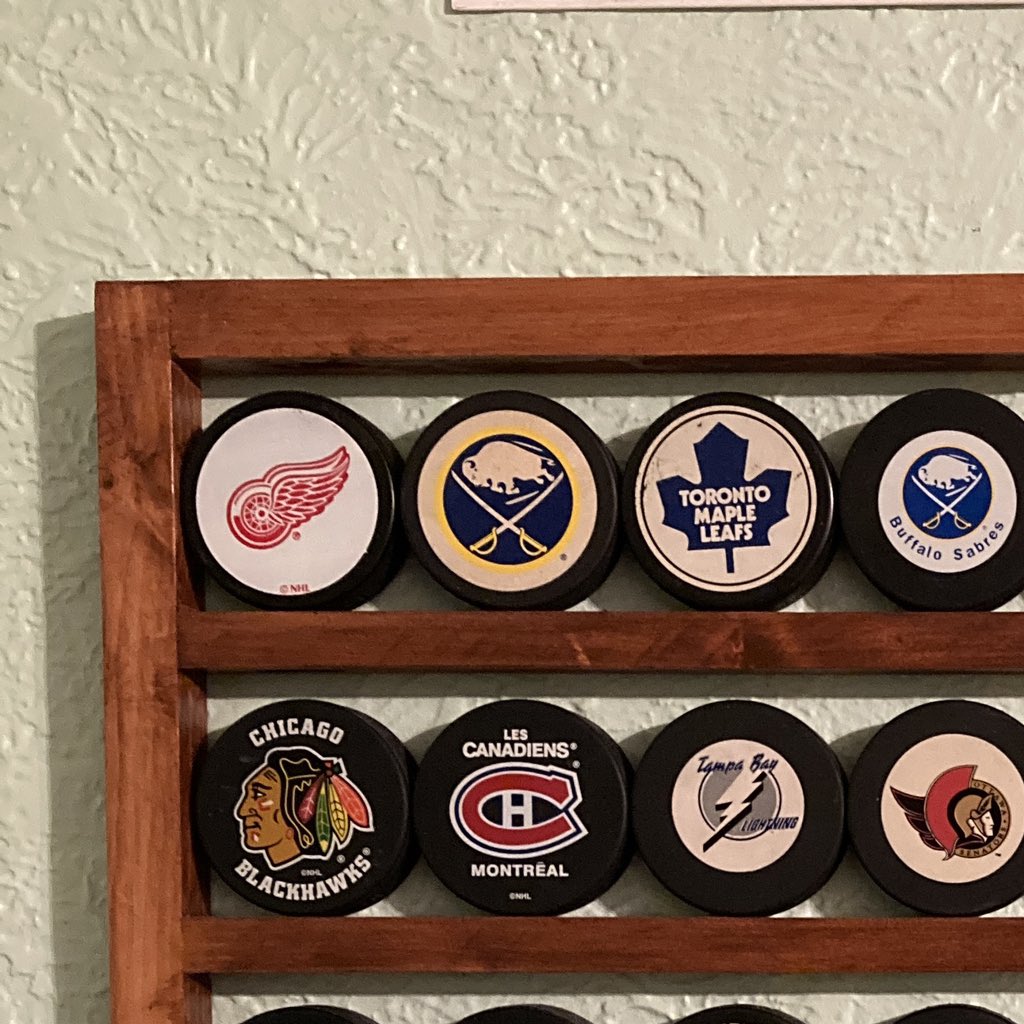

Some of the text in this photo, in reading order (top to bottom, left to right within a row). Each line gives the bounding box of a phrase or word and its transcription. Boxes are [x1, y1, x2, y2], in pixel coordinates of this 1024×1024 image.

[679, 486, 771, 507] TORONTO
[694, 505, 757, 525] MAPLE
[700, 524, 753, 543] LEAFS
[889, 515, 1004, 561] Buffalo Sabres
[291, 584, 310, 594] NHL
[248, 718, 345, 747] CHICAGO
[503, 729, 528, 741] LES
[463, 742, 569, 758] CANADIENS
[697, 754, 778, 774] Tampa Bay
[741, 816, 797, 831] LIGHTNING
[234, 855, 371, 901] BLACKHAWKS
